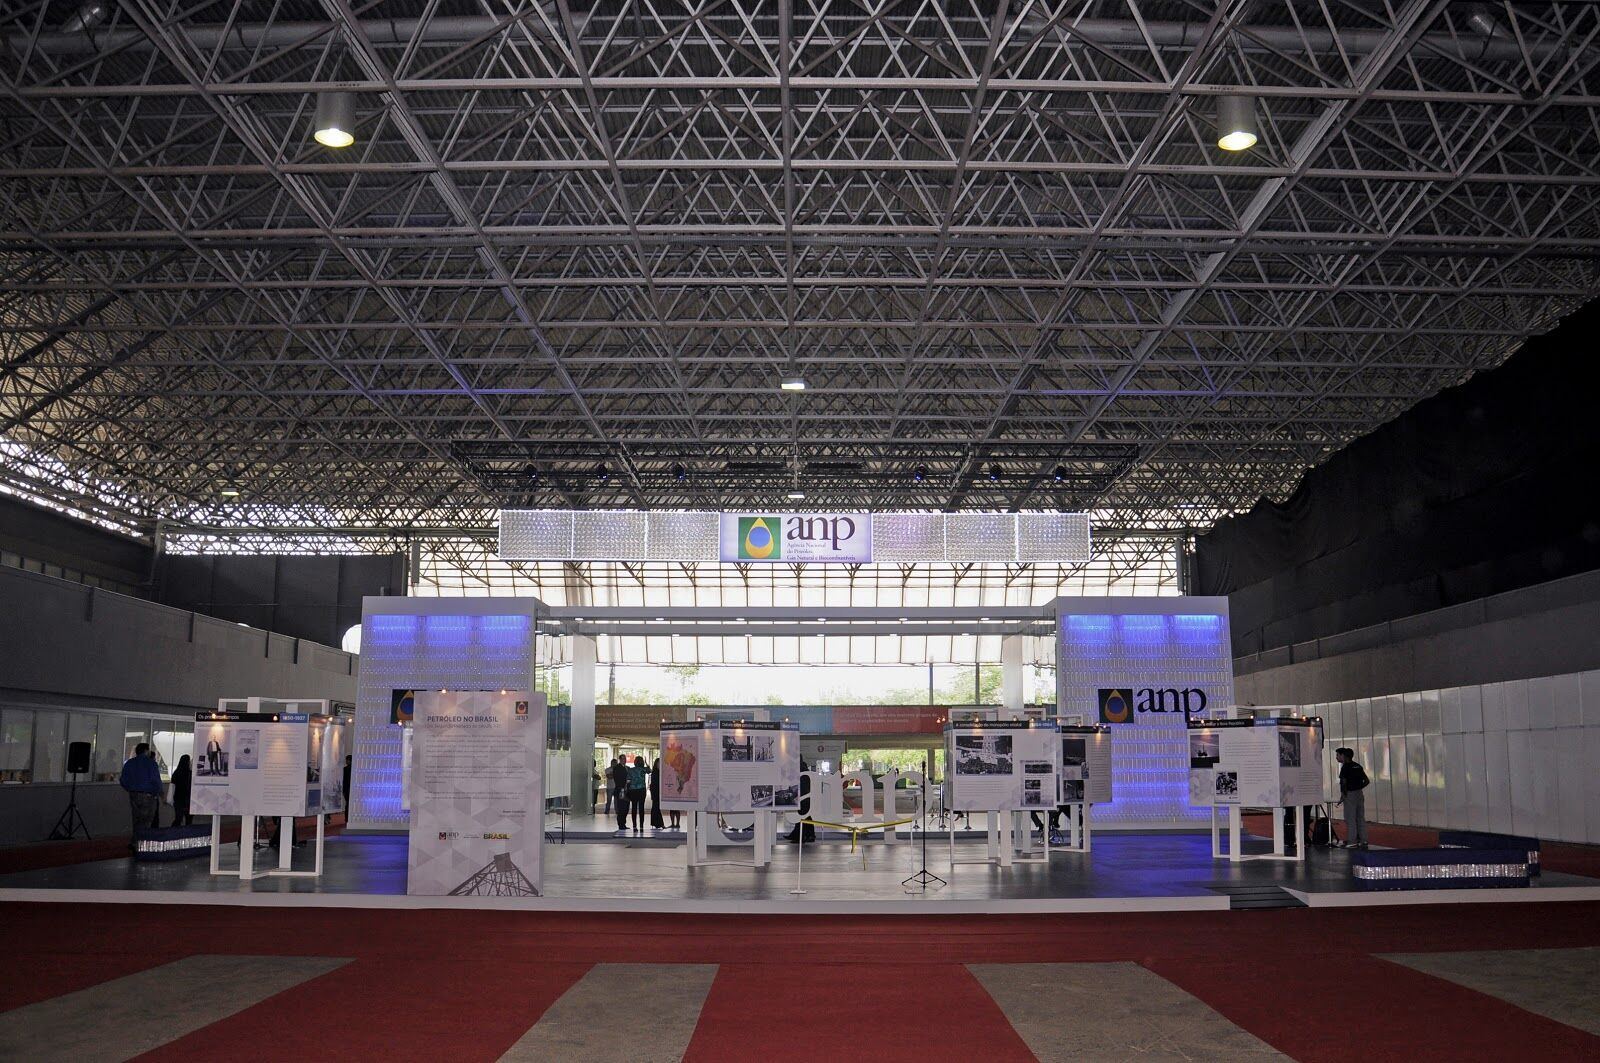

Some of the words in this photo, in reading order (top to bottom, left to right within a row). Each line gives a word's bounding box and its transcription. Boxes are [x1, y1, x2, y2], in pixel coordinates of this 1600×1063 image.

[787, 516, 855, 550] anp
[427, 715, 462, 723] PETRÓLEO
[1137, 688, 1207, 723] anp
